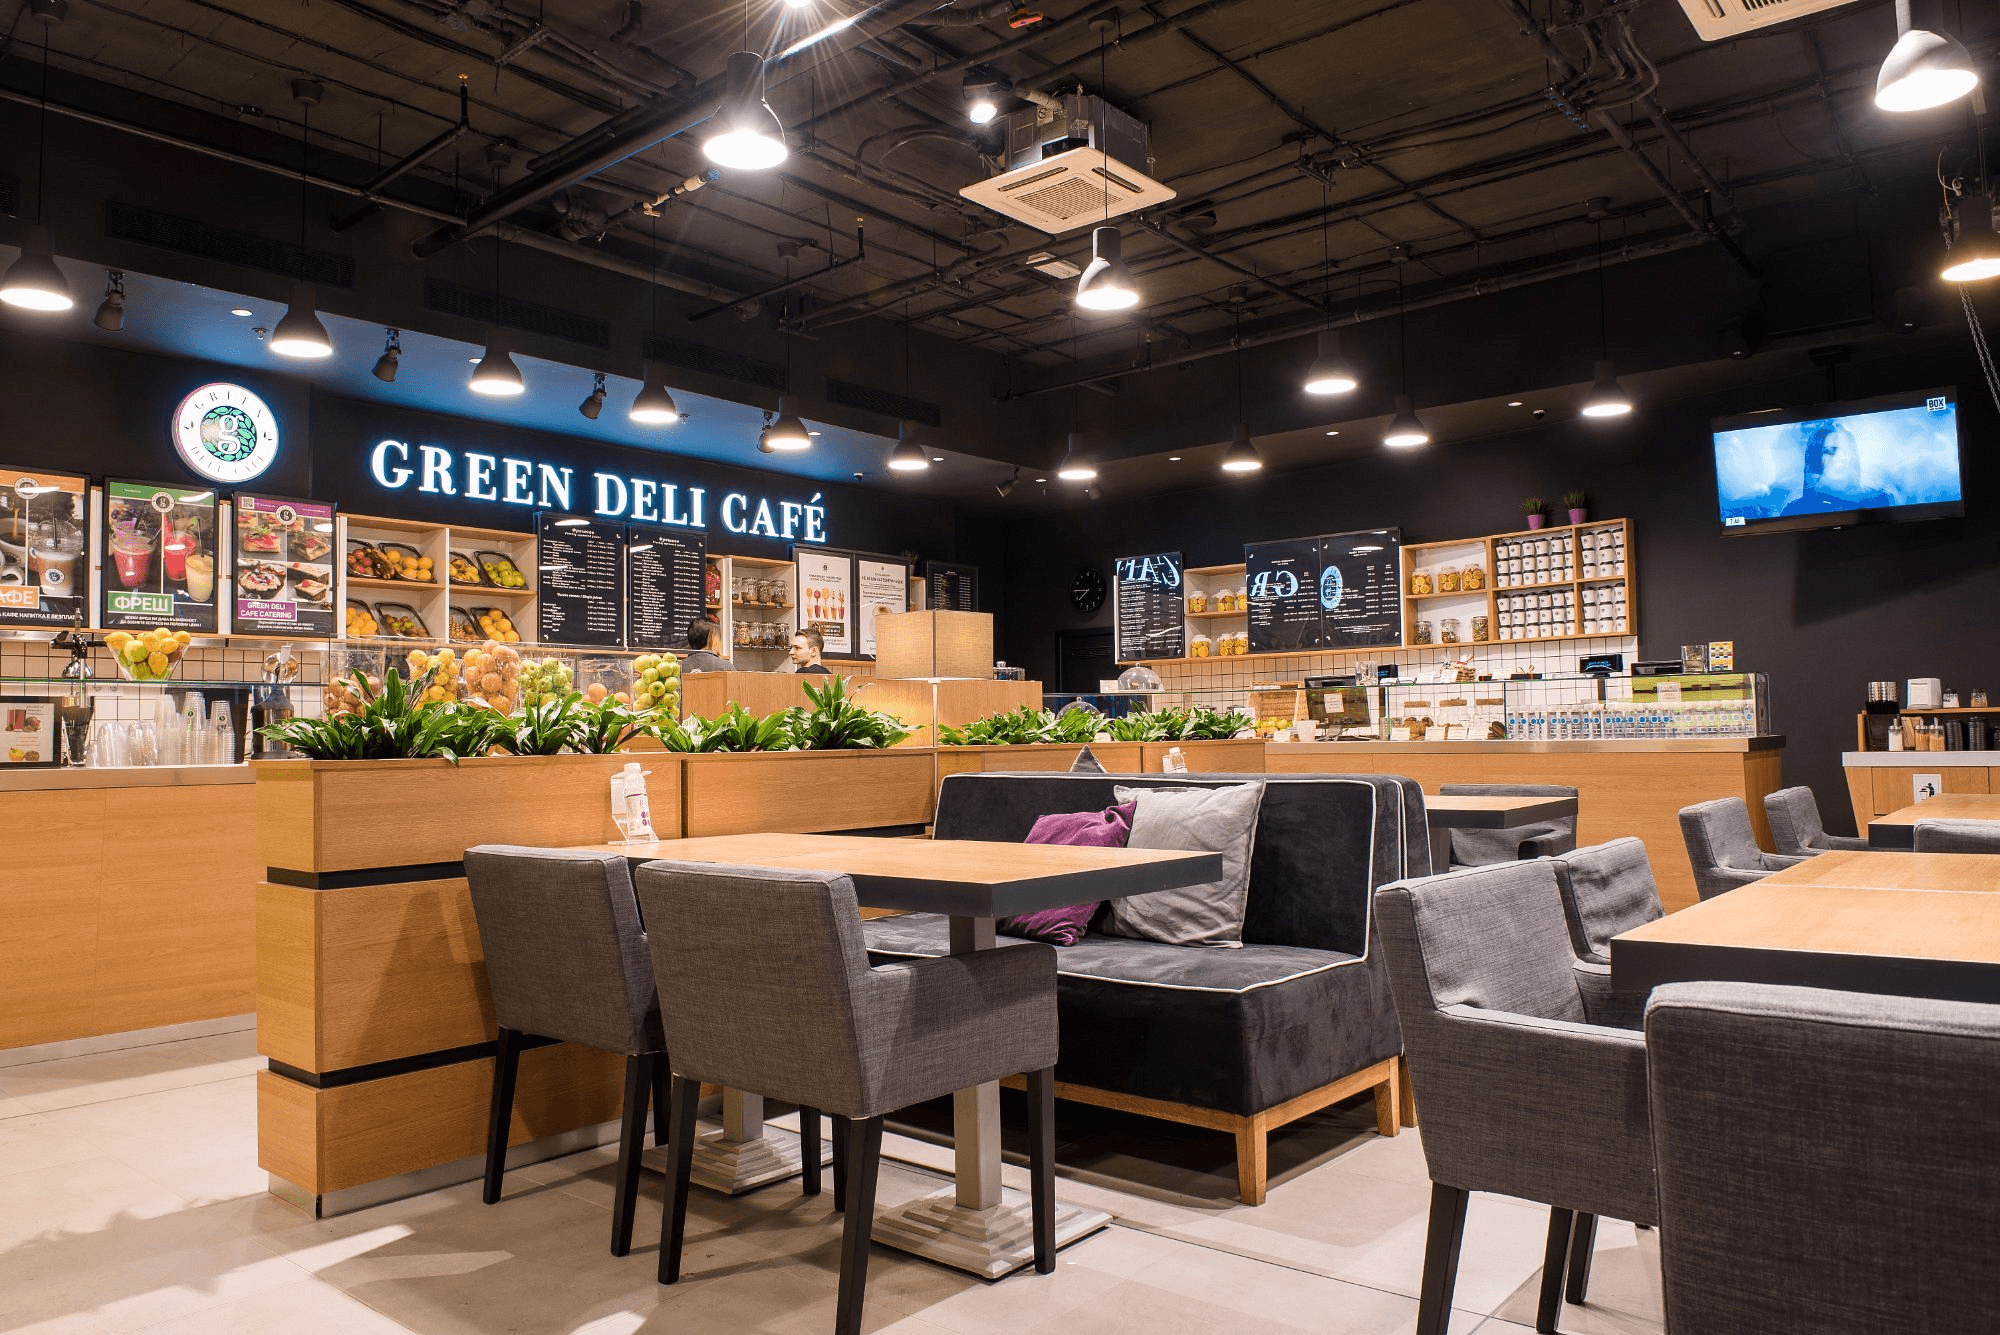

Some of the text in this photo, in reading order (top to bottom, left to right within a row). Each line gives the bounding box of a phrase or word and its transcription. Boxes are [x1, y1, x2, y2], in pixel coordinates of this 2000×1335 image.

[1928, 398, 1944, 409] BOX
[217, 414, 245, 455] g
[371, 439, 826, 543] GREEN DELI CAFÉ
[115, 595, 168, 612] ФРЕШ
[271, 602, 286, 610] DELI
[259, 611, 292, 619] CATERING
